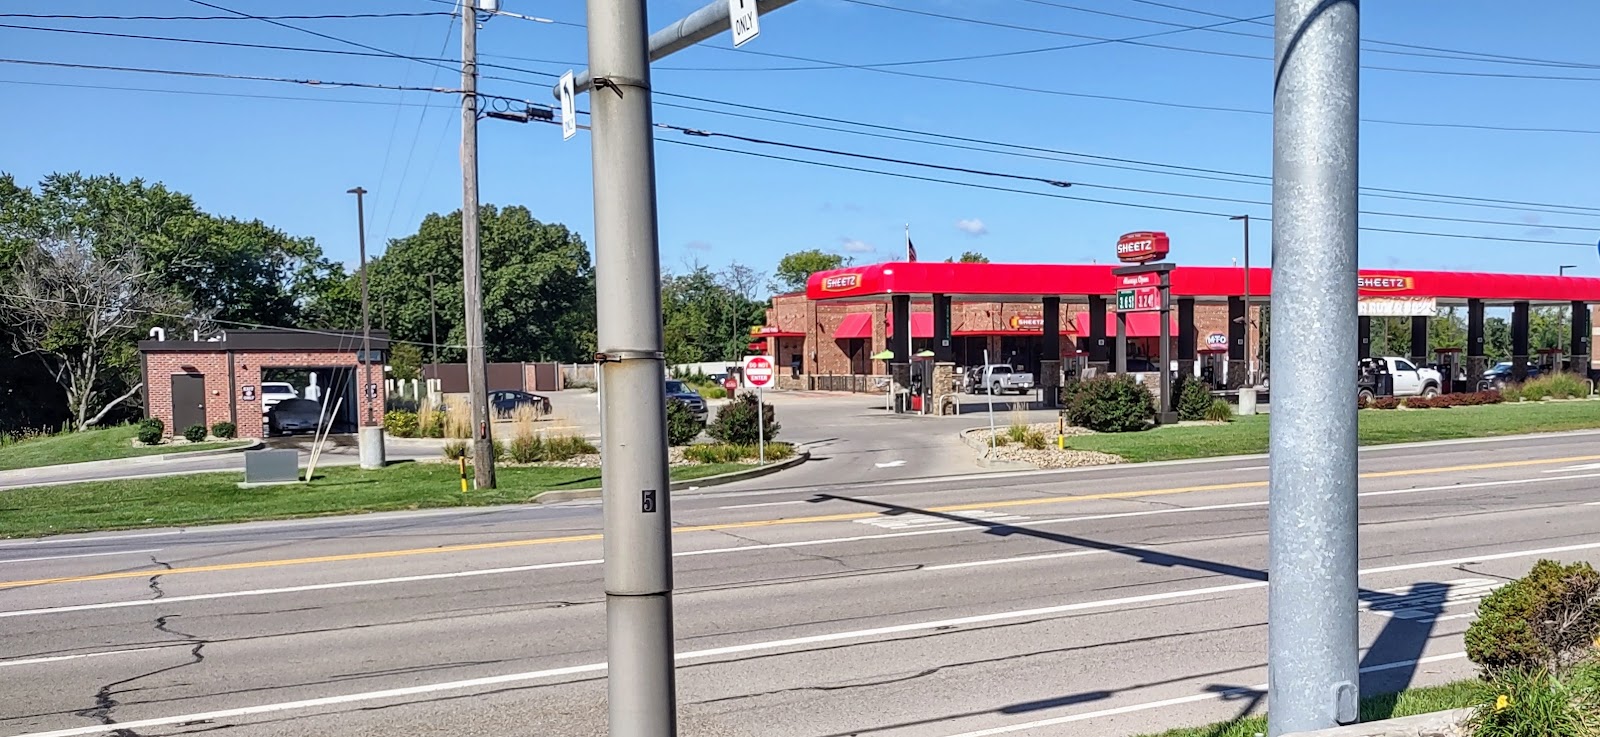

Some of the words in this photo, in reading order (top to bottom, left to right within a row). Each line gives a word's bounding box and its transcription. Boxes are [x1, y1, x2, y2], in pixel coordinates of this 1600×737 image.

[736, 11, 753, 36] ONLY
[1117, 239, 1152, 254] SHEETZ
[827, 275, 856, 289] SHEETZ
[1357, 277, 1404, 287] SHEETZ
[643, 491, 654, 512] 5
